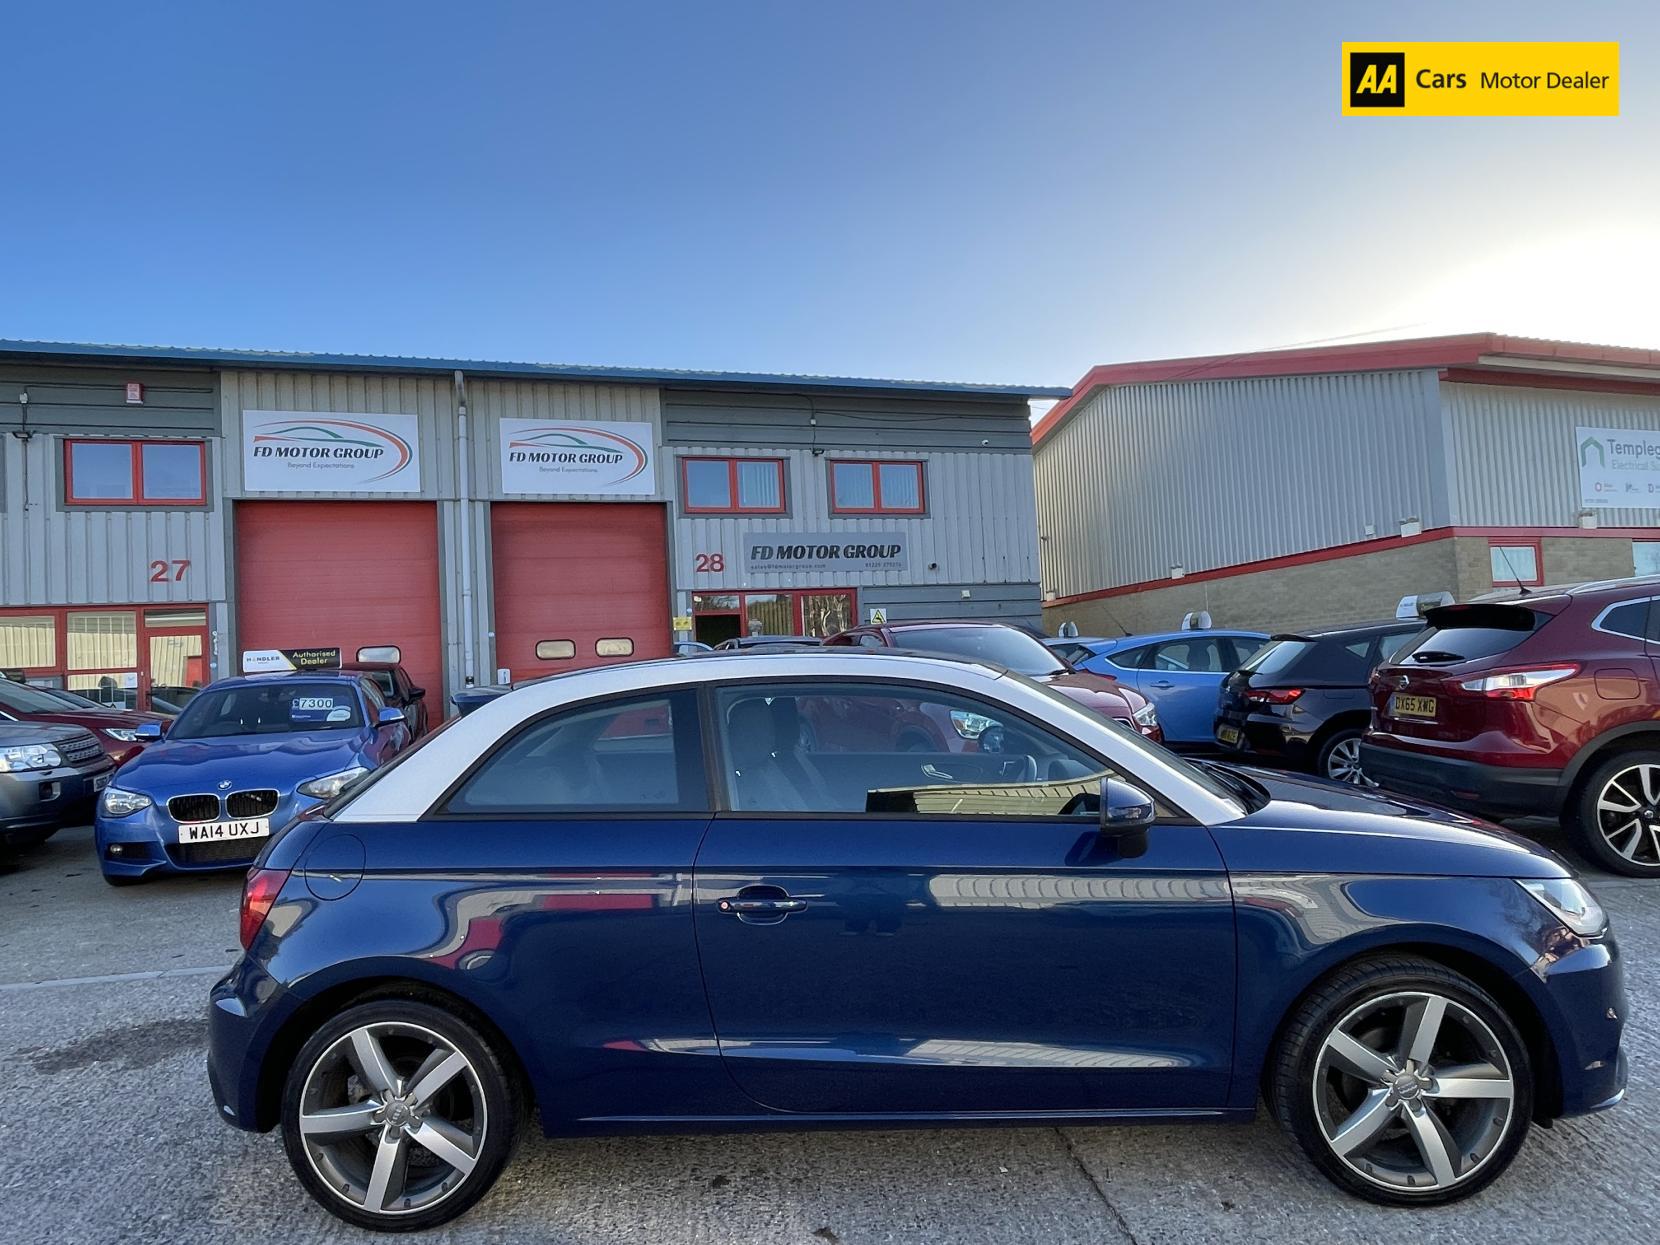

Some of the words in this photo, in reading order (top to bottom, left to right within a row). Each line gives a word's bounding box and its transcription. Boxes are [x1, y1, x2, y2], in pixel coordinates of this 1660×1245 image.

[253, 446, 272, 457] FD
[275, 447, 330, 458] MOTOR
[333, 448, 384, 459] GROUP
[509, 452, 526, 462] FD
[528, 452, 576, 463] MOTOR
[579, 454, 623, 464] GROUP
[287, 461, 312, 469] Beyond
[313, 461, 355, 469] Expectations
[751, 545, 774, 560] FD
[776, 544, 840, 560] MOTOR
[843, 544, 901, 559] GROUP
[696, 553, 725, 573] 28
[151, 560, 190, 582] 27
[292, 650, 336, 658] Authorised
[300, 657, 328, 666] Dealer
[1395, 697, 1416, 711] DX65
[1418, 698, 1435, 713] XWG
[189, 826, 224, 840] WA14
[228, 822, 260, 836] UXJ
